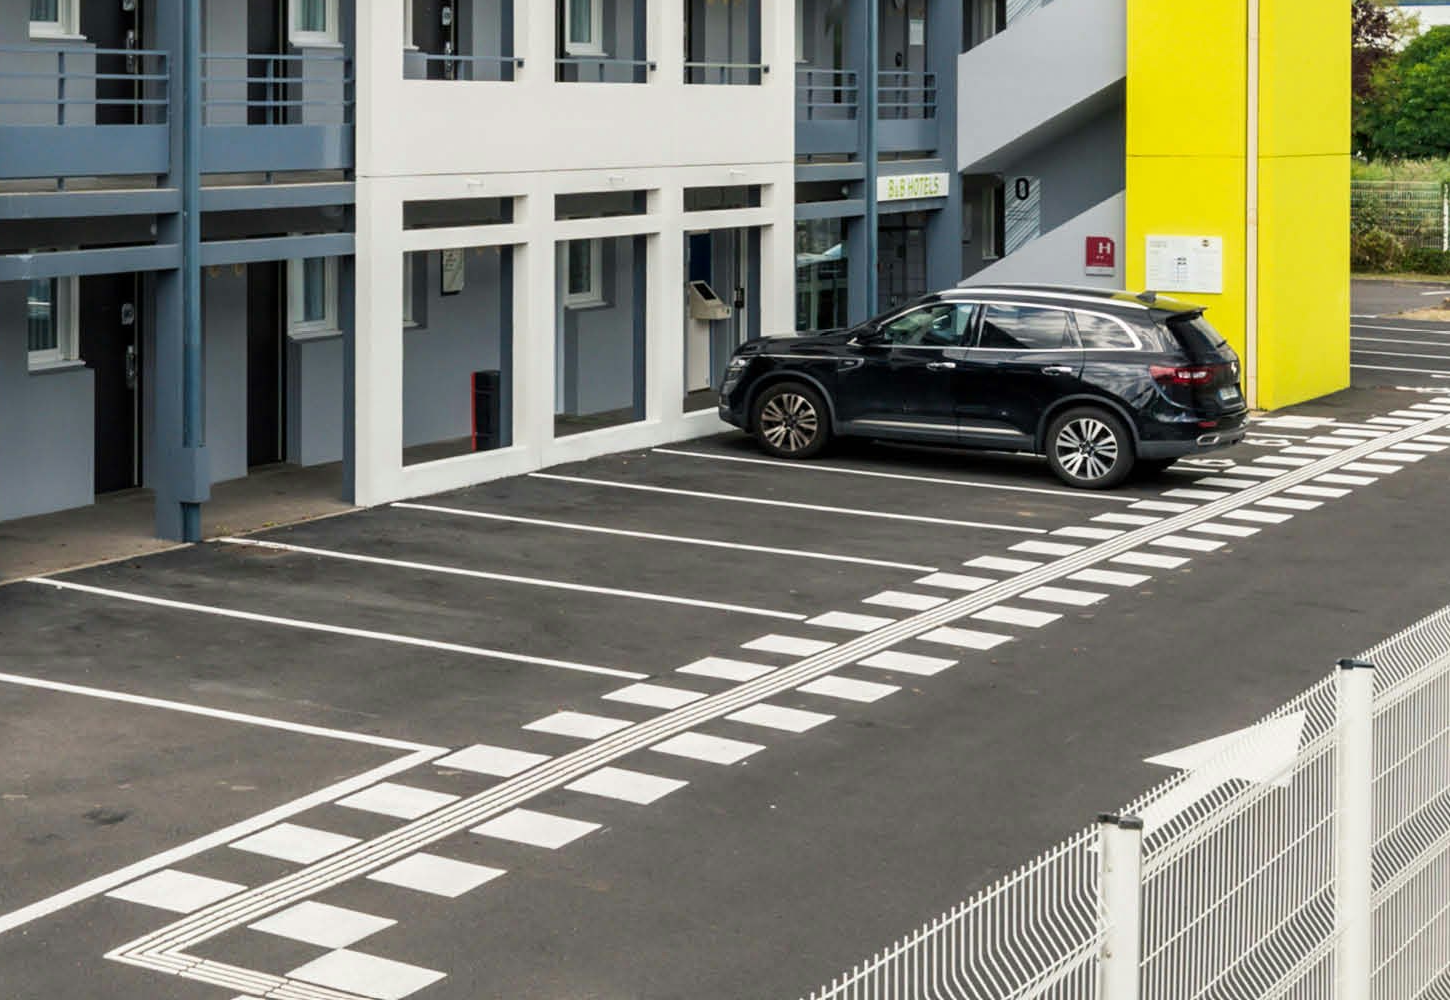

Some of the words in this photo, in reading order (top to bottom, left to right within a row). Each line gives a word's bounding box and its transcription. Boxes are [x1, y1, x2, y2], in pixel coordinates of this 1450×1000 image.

[908, 176, 939, 196] HOTELS
[1015, 178, 1029, 200] 0
[1098, 242, 1111, 254] H
